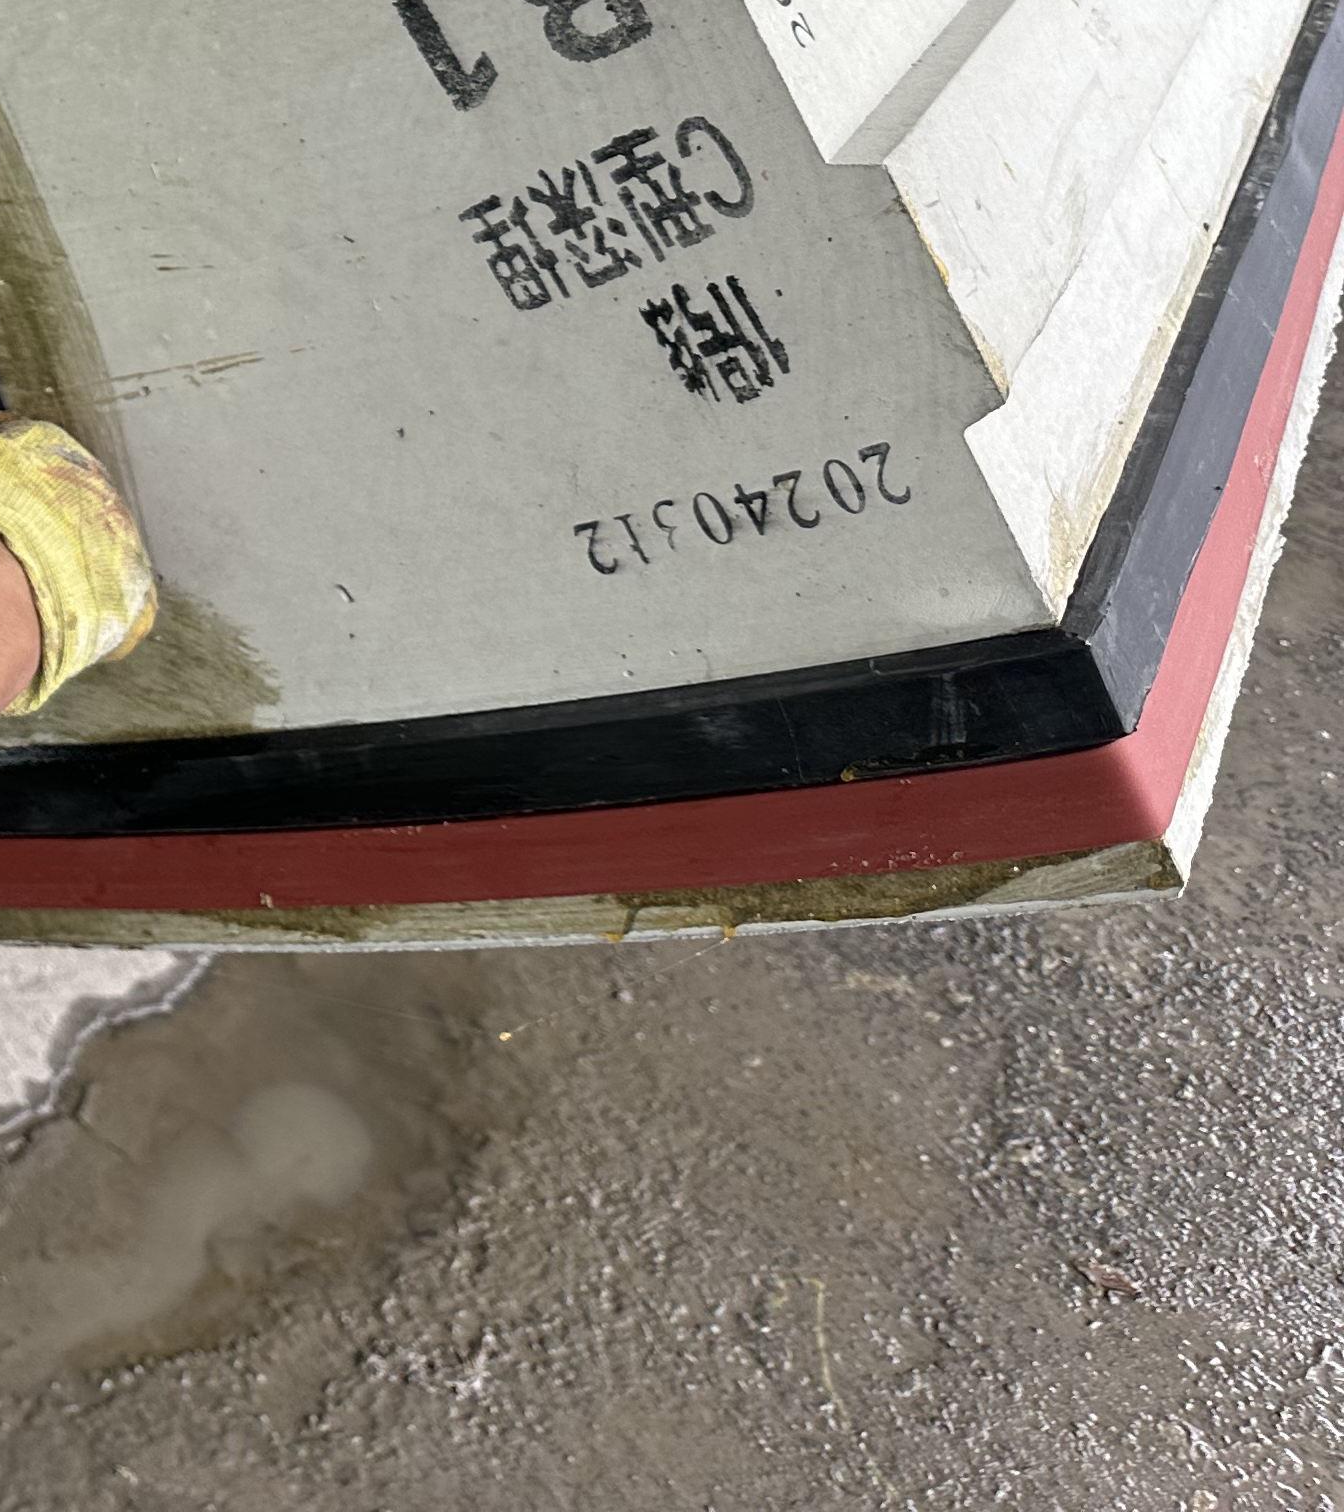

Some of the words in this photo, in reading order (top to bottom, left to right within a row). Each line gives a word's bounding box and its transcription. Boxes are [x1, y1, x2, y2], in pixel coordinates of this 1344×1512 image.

[458, 116, 756, 313] C型深埋
[572, 444, 912, 574] 20240312
